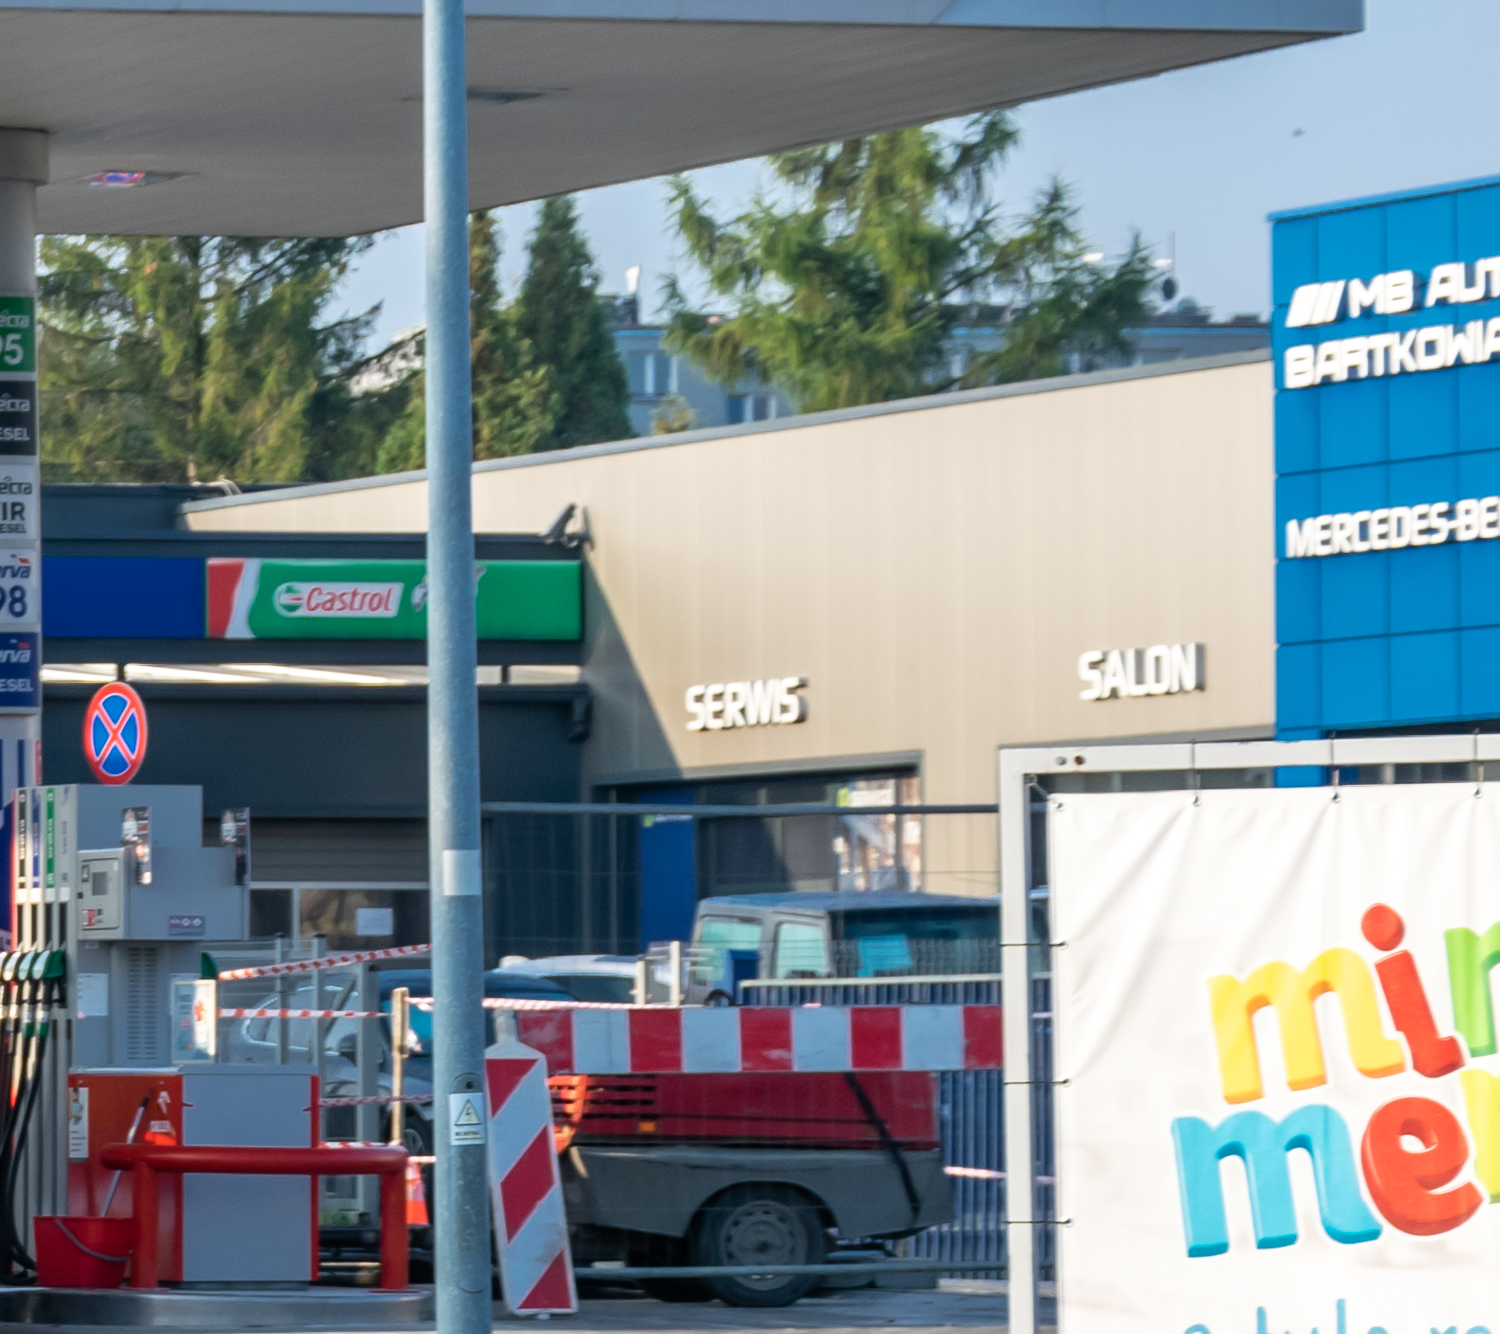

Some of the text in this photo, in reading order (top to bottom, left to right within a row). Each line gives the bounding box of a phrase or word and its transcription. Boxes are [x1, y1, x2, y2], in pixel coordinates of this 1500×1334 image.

[1348, 269, 1414, 318] MB
[305, 586, 393, 612] Castrol
[1078, 643, 1202, 701] SALON
[685, 677, 804, 732] SERWIS
[1171, 1069, 1500, 1257] me
